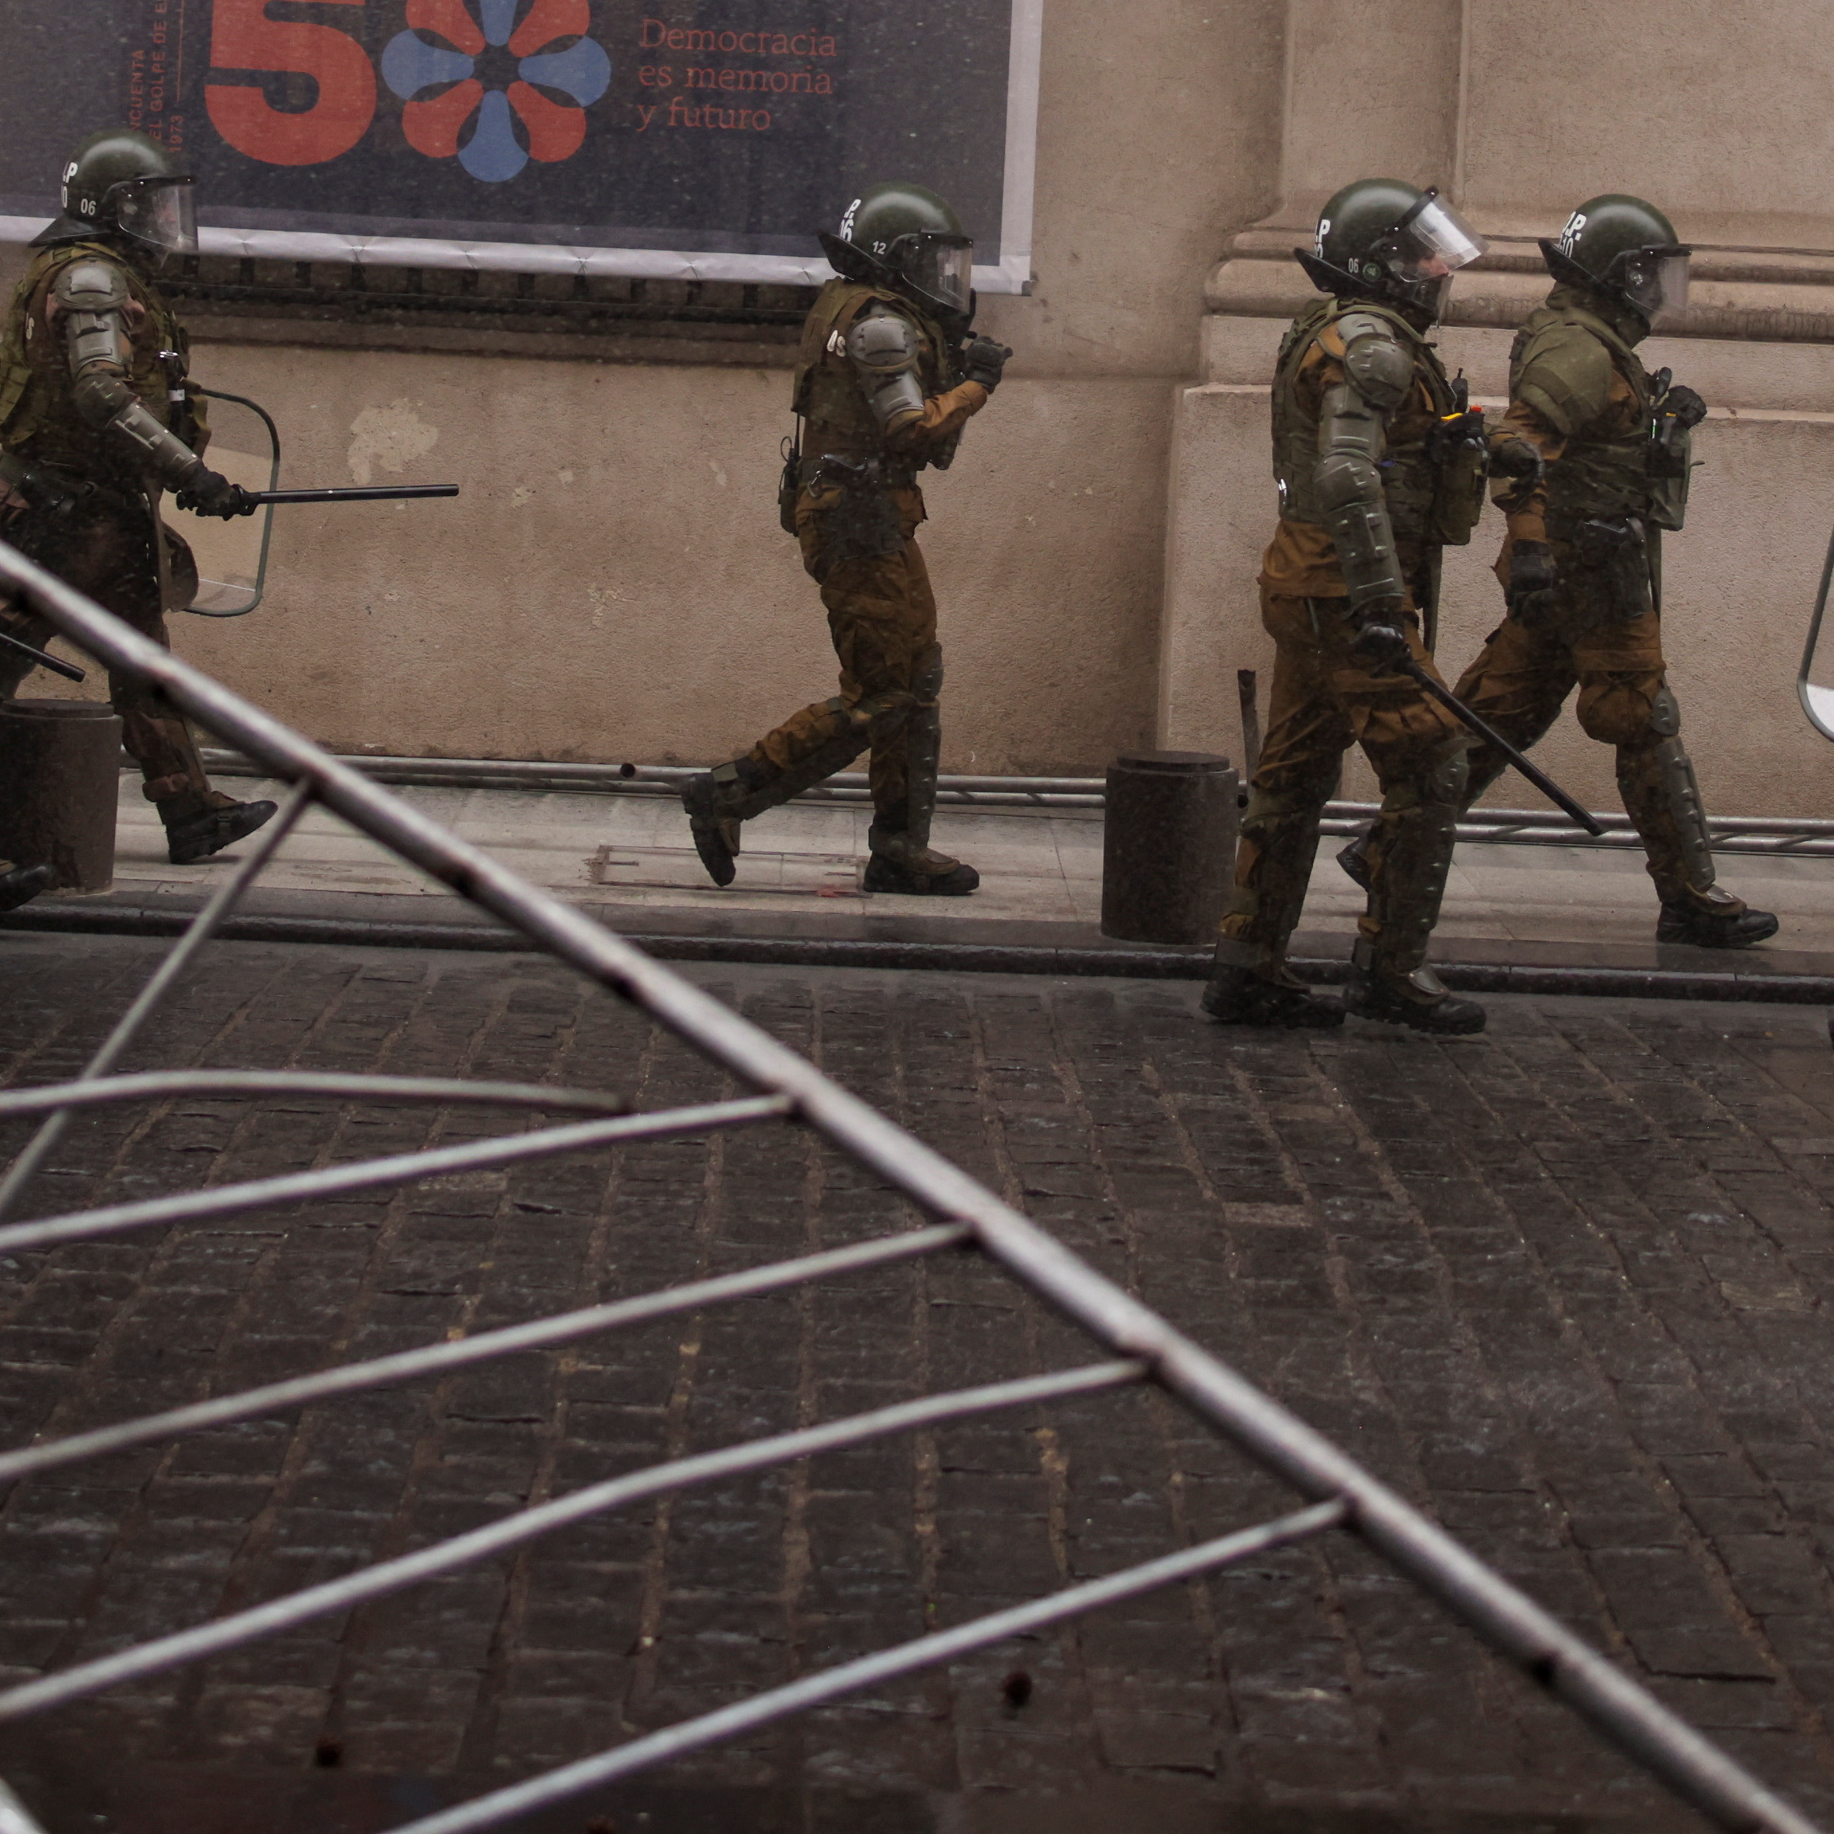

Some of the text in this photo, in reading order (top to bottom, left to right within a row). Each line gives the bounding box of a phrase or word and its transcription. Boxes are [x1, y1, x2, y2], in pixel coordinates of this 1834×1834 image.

[153, 20, 168, 45] DE
[639, 18, 837, 56] Democracia
[129, 50, 145, 131] NCUENTA
[150, 51, 165, 112] GOLPE
[638, 65, 833, 94] es memoria
[636, 96, 772, 132] y futuro
[148, 119, 163, 141] EL
[170, 115, 184, 152] 1973
[81, 198, 96, 216] 06
[872, 240, 887, 255] 12
[1348, 258, 1359, 273] 06
